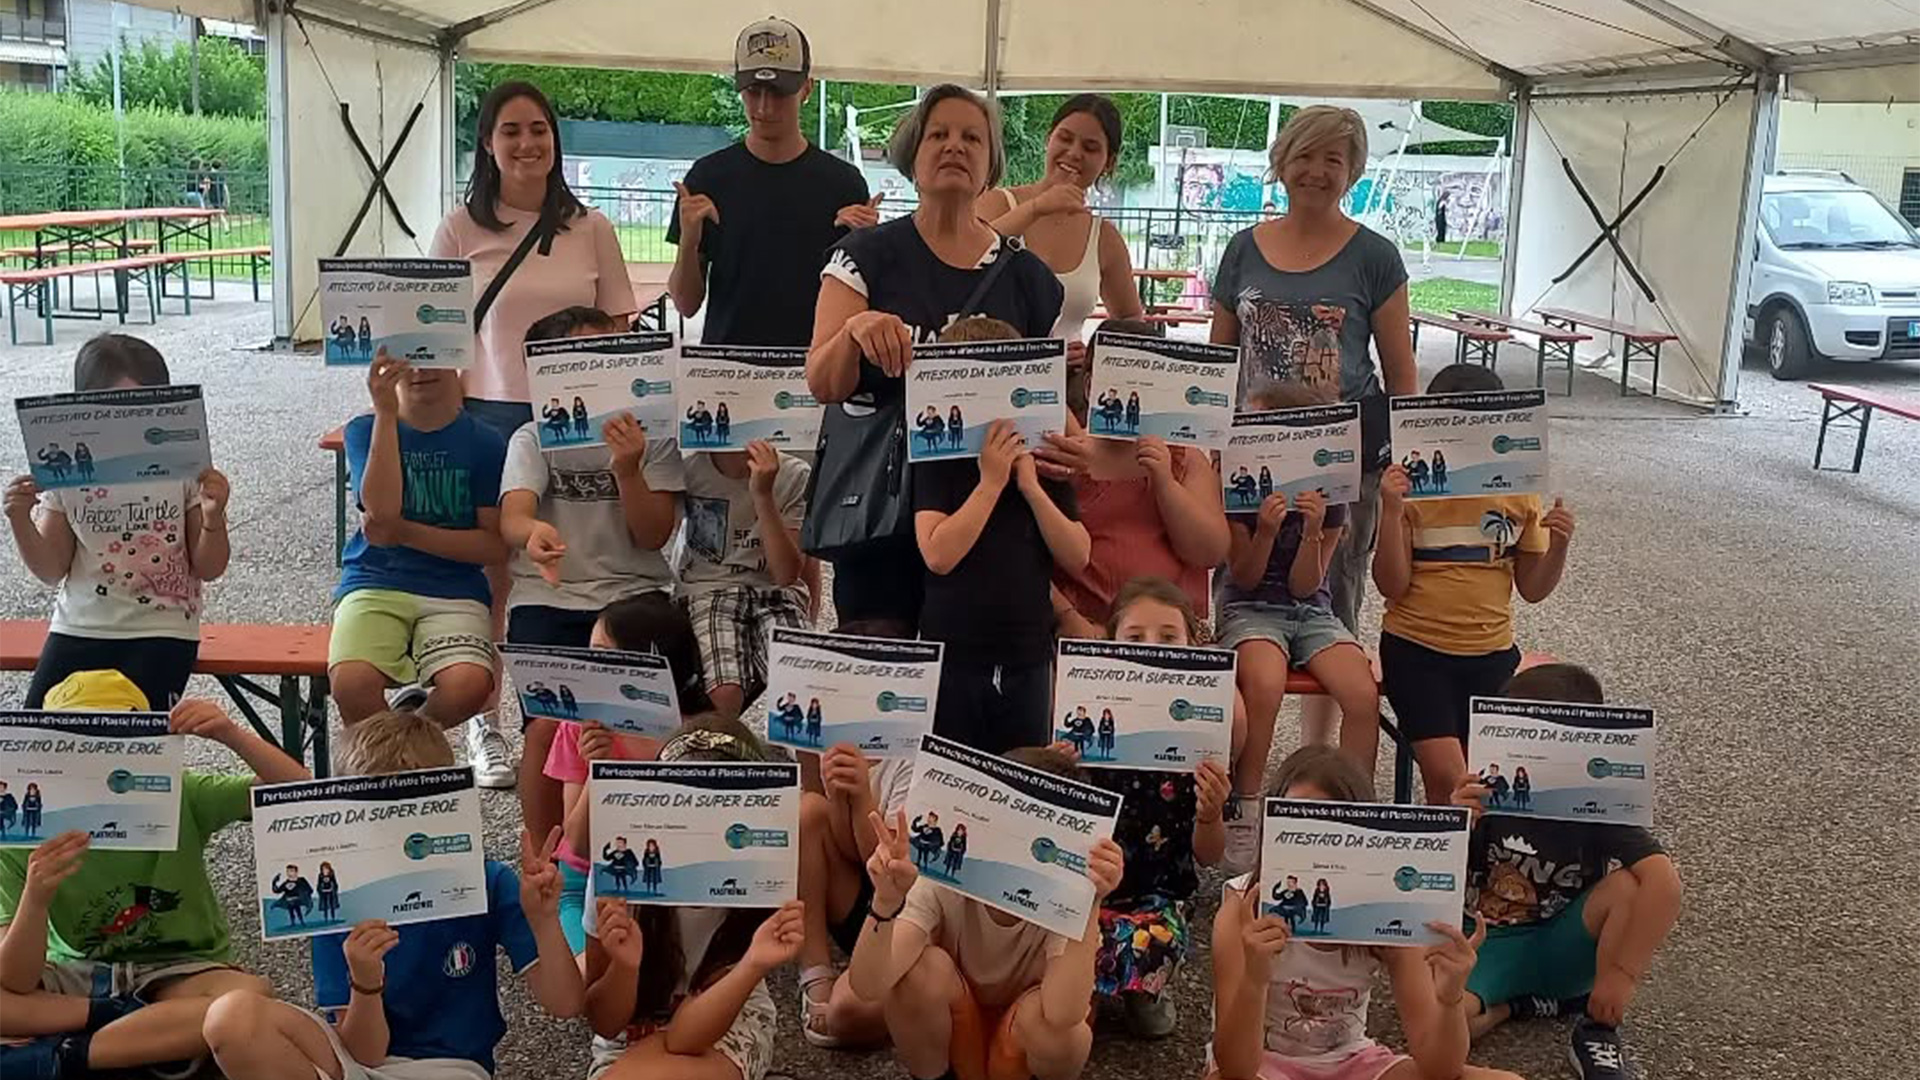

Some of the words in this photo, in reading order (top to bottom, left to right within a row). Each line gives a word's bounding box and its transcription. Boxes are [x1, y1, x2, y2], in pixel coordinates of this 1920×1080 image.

[328, 281, 375, 291] ATTESTATO
[377, 281, 391, 291] DA
[393, 282, 428, 292] SUPER
[430, 283, 459, 292] EROE
[537, 361, 587, 375] ATTESTATO
[590, 359, 603, 370] DA
[606, 358, 639, 367] SUPER
[641, 356, 664, 366] EROE
[687, 368, 735, 379] ATTESTATO
[737, 369, 751, 379] DA
[753, 370, 785, 380] SUPER
[914, 368, 968, 381] ATTESTATO
[970, 367, 985, 378] DA
[987, 365, 1021, 377] SUPER
[1025, 363, 1052, 374] EROE
[1102, 356, 1150, 369] ATTESTATO
[1152, 361, 1165, 371] DA
[1167, 364, 1198, 375] SUPER
[1200, 366, 1227, 377] EROE
[30, 412, 92, 425] ATTESTATO
[94, 410, 111, 420] DA
[114, 408, 154, 418] SUPER
[157, 405, 188, 416] EROE
[1399, 418, 1449, 428] ATTESTATO
[1452, 416, 1466, 426] DA
[1469, 414, 1503, 425] SUPER
[1505, 412, 1534, 423] EROE
[1228, 433, 1276, 446] ATTESTATO
[1277, 432, 1290, 441] DA
[1292, 429, 1323, 440] SUPER
[1324, 426, 1349, 436] EROE
[121, 500, 180, 522] Turtle
[126, 522, 150, 531] Love
[514, 659, 568, 670] ATTESTATO
[589, 666, 626, 675] SUPER
[629, 669, 659, 679] EROE
[778, 655, 833, 672] ATTESTATO
[835, 662, 852, 673] DA
[854, 665, 893, 676] SUPER
[895, 667, 925, 679] EROE
[1067, 667, 1124, 681] ATTESTATO
[1126, 671, 1143, 682] DA
[1146, 672, 1184, 686] SUPER
[1186, 675, 1220, 687] EROE
[1479, 726, 1538, 739] ATTESTATO
[1540, 729, 1557, 740] DA
[1560, 731, 1601, 744] SUPER
[1603, 733, 1638, 746] EROE
[55, 740, 74, 753] DA
[78, 742, 125, 754] SUPER
[127, 742, 166, 755] EROE
[599, 768, 655, 778] Partecipando
[708, 768, 716, 777] di
[718, 768, 745, 778] Plastic
[747, 769, 765, 778] Free
[766, 770, 789, 778] Onlus
[928, 741, 982, 767] Partecipando
[1029, 775, 1039, 784] di
[1038, 778, 1067, 794] Plastic
[1067, 786, 1087, 800] Free
[1088, 794, 1112, 807] Onlus
[262, 789, 323, 803] Partecipando
[389, 777, 419, 787] Plastic
[421, 775, 440, 785] Free
[441, 773, 466, 782] Onlus
[602, 793, 670, 807] ATTESTATO
[673, 793, 692, 807] DA
[696, 795, 741, 807] SUPER
[744, 795, 781, 807] EROE
[923, 768, 988, 798] ATTESTATO
[989, 789, 1009, 804] DA
[1011, 798, 1057, 822] SUPER
[1057, 813, 1096, 834] EROE
[267, 811, 342, 833] ATTESTATO
[346, 809, 365, 824] DA
[369, 803, 418, 821] SUPER
[420, 799, 459, 815] EROE
[1275, 831, 1342, 845] ATTESTATO
[1345, 834, 1363, 847] DA
[1366, 836, 1410, 850] SUPER
[1413, 838, 1450, 851] EROE
